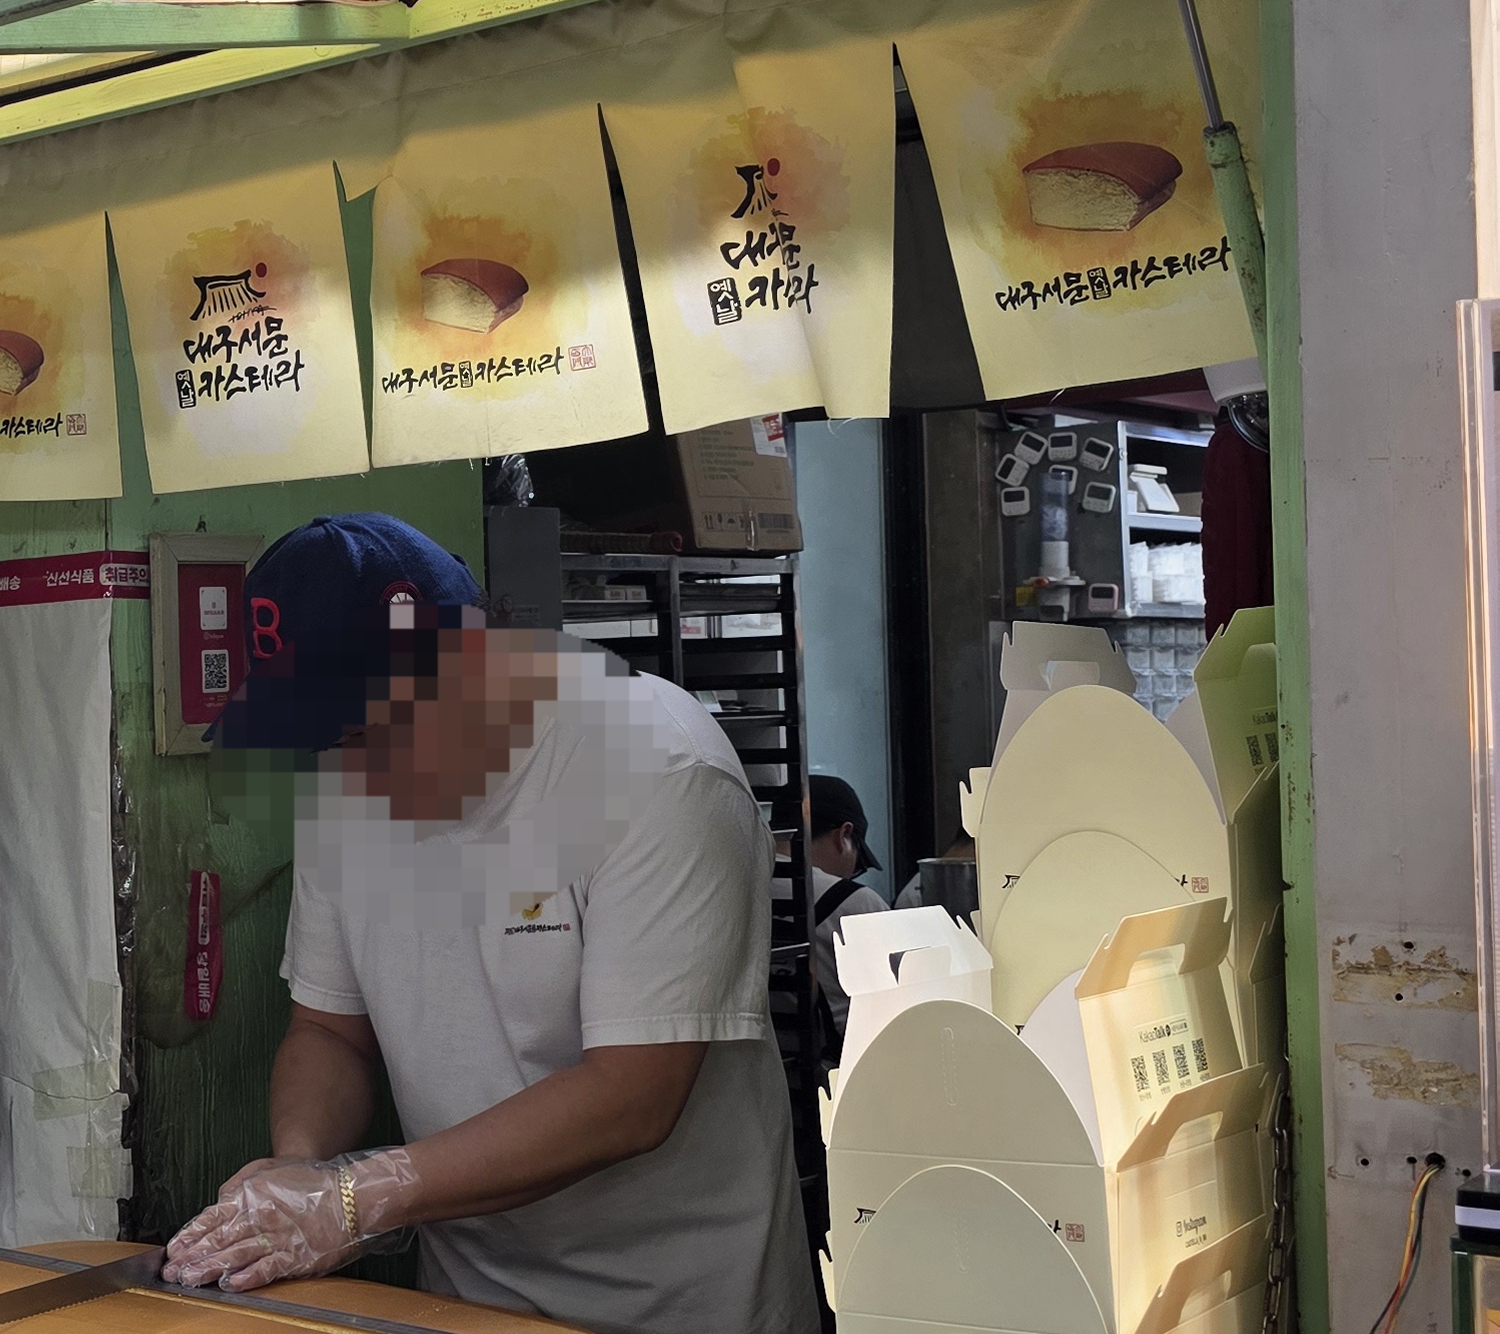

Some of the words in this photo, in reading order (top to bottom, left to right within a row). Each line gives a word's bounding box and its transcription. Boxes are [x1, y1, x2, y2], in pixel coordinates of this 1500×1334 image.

[995, 274, 1090, 312] 대구서문
[1112, 236, 1233, 292] 카스테라
[183, 315, 289, 364] 대구서문
[198, 349, 305, 402] 카스테라
[382, 362, 458, 394] 대구서문
[474, 345, 565, 384] 카스테라
[0, 412, 63, 439] 카스테라
[47, 568, 95, 588] 신선식품
